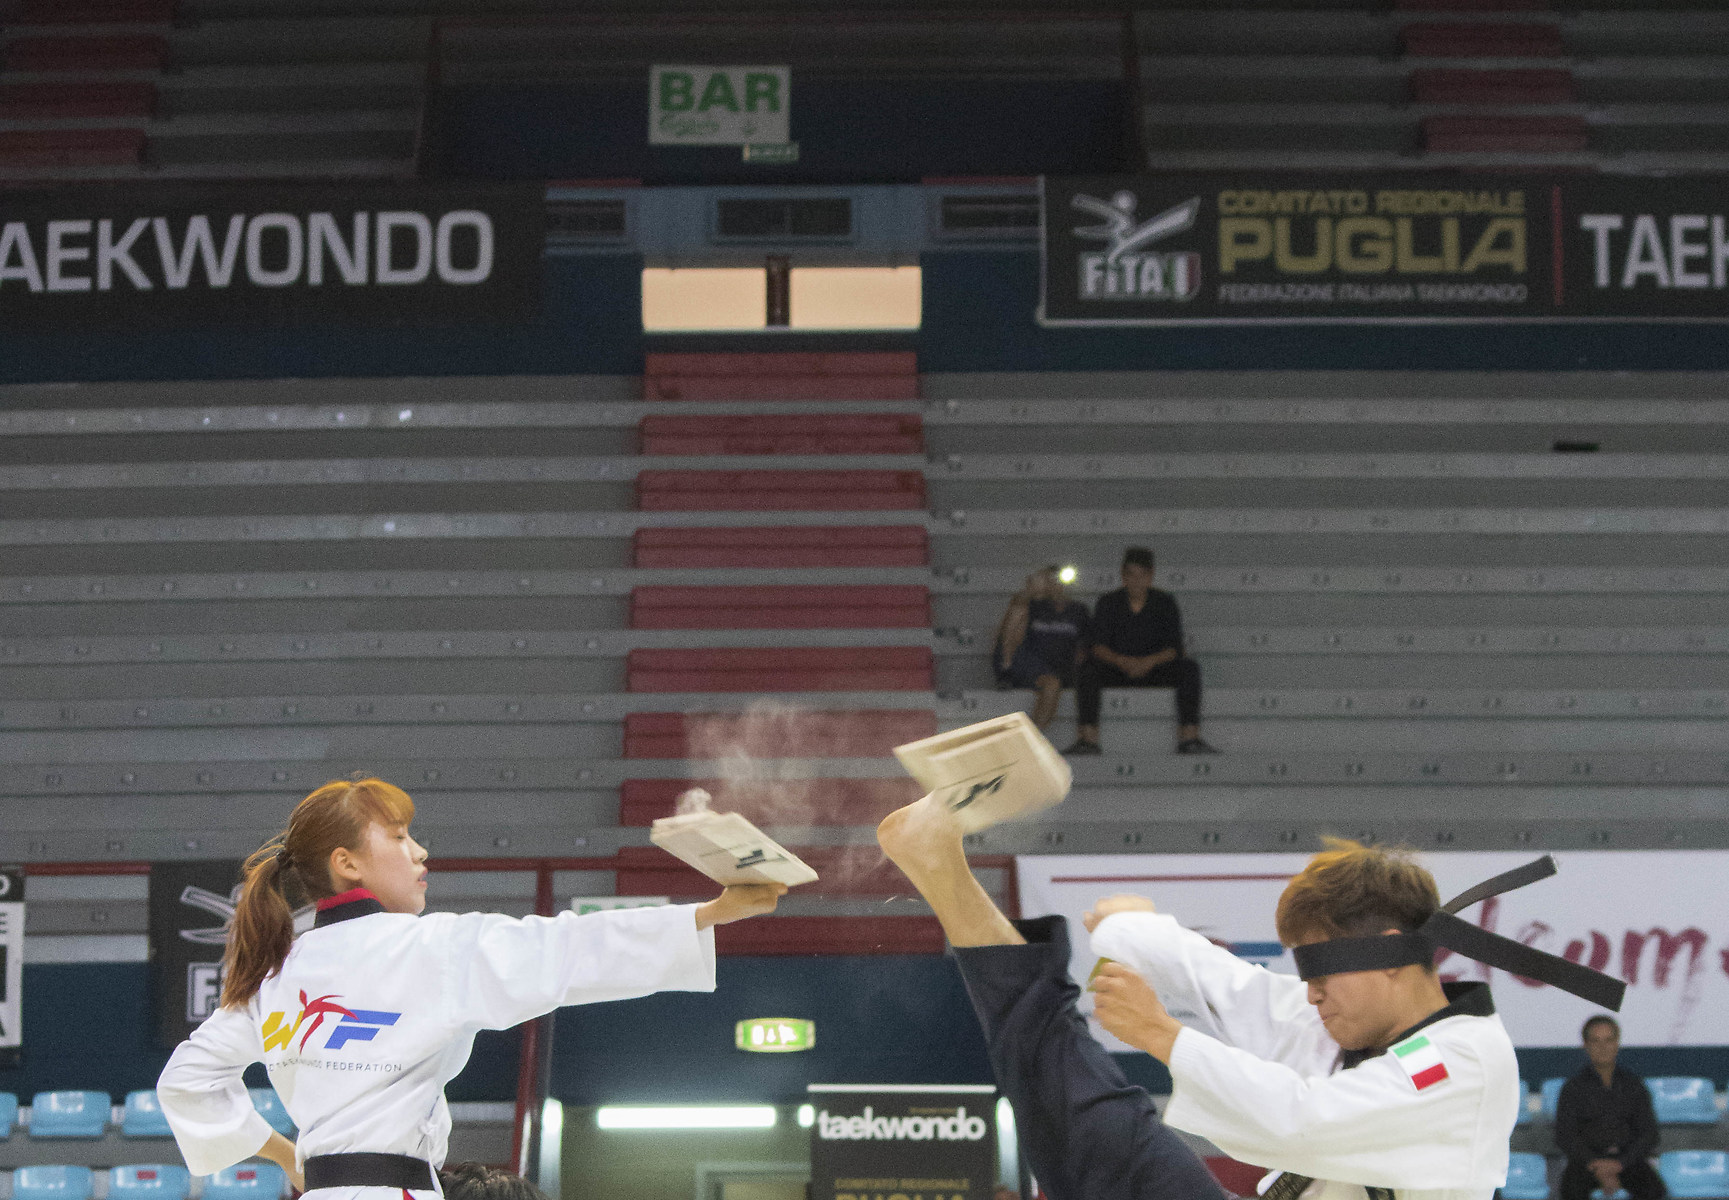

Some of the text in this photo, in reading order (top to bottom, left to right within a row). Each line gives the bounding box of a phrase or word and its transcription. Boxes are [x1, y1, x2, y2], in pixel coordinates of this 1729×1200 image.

[660, 72, 780, 112] BAR
[1218, 189, 1525, 214] COMITATO REGIONALE
[1219, 217, 1527, 273] PUGLIA
[326, 1061, 402, 1073] FEDERATION
[818, 1105, 986, 1140] taekwondo
